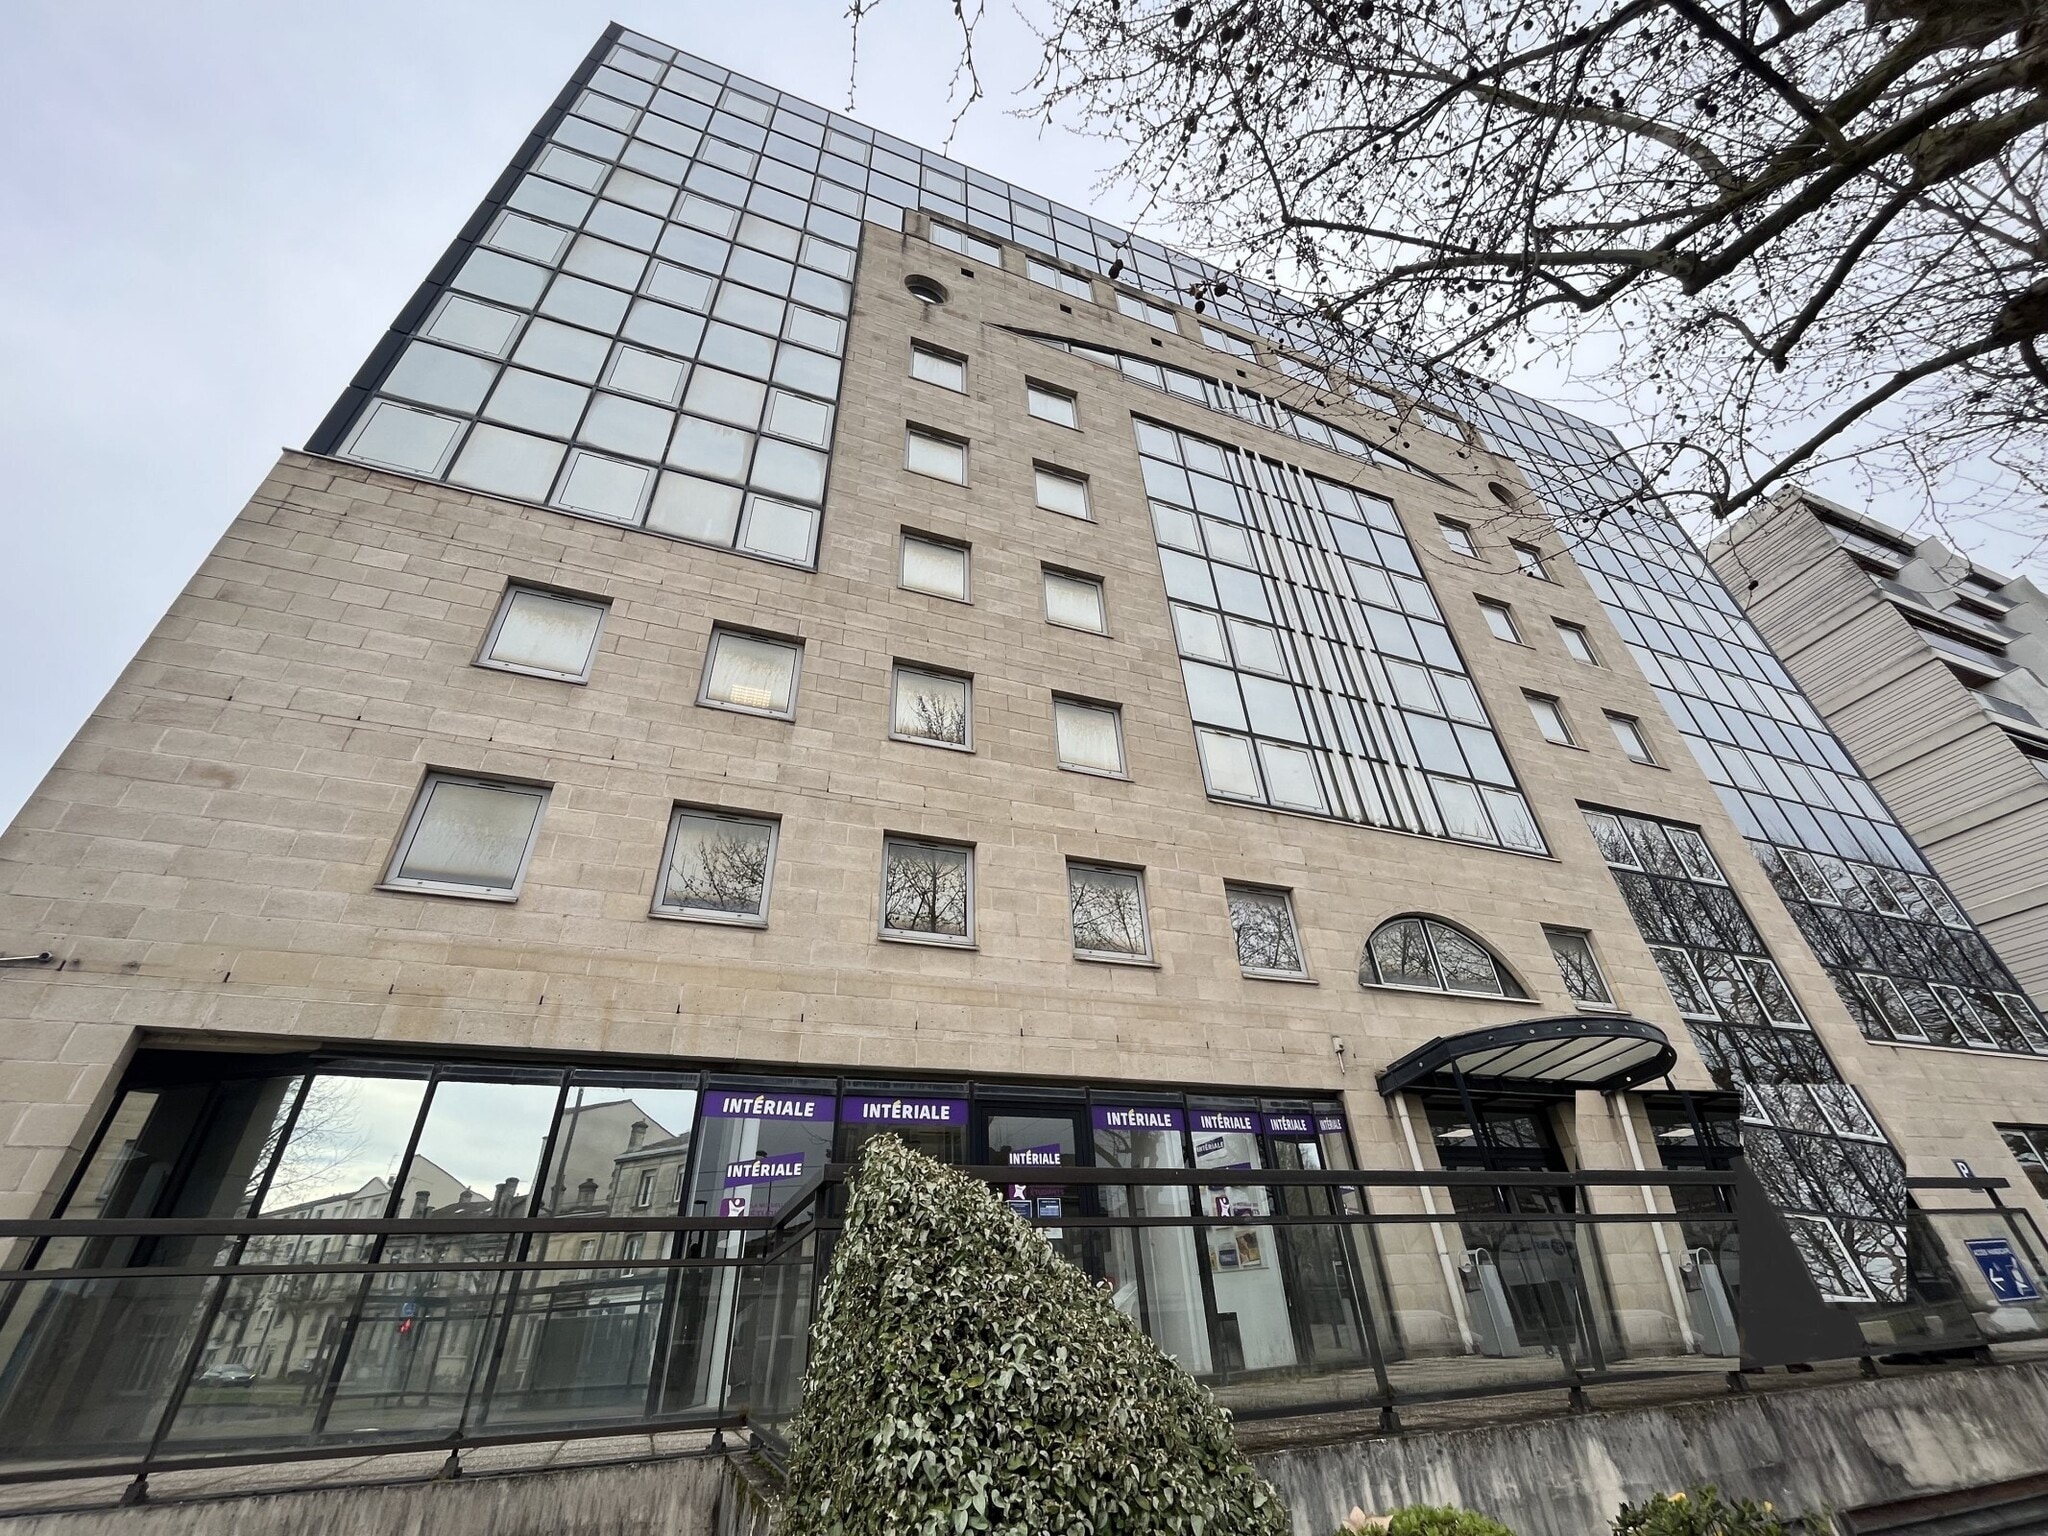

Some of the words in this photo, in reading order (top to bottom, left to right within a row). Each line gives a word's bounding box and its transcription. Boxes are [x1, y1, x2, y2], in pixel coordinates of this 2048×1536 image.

[722, 1095, 815, 1117] INTÉRIALE
[863, 1100, 950, 1120] INTÉRIALE
[1106, 1108, 1172, 1127] INTÉRIALE
[1201, 1113, 1252, 1130] INTÉRIALE
[1270, 1115, 1307, 1131] INTÉRIALE
[1009, 1149, 1061, 1165] INTÉRIALE
[727, 1160, 803, 1178] INTÉRIALE
